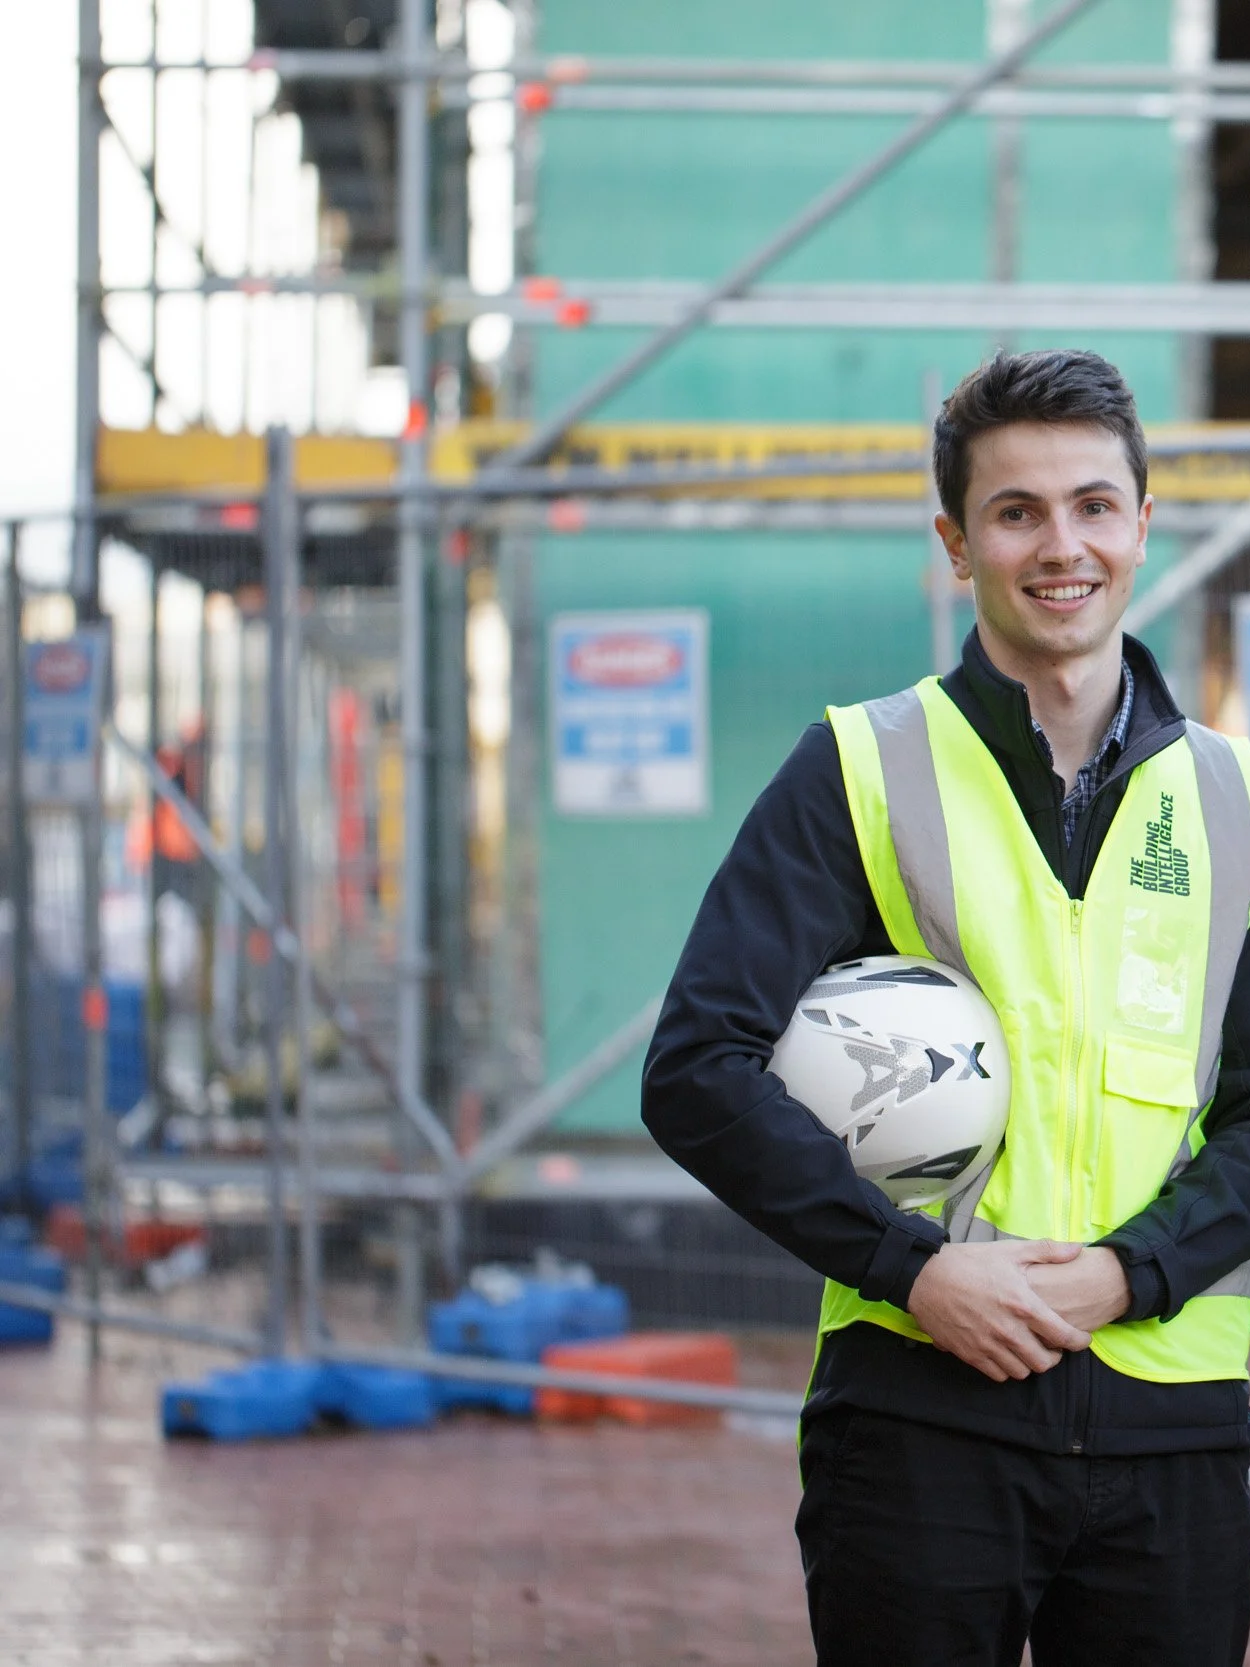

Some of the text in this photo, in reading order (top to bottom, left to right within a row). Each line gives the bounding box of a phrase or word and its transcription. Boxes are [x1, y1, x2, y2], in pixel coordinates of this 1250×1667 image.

[1130, 857, 1144, 887] THE
[1143, 821, 1160, 892] BUILDING
[1158, 791, 1174, 895] INTELLIGENCE
[1173, 848, 1191, 897] GROUP
